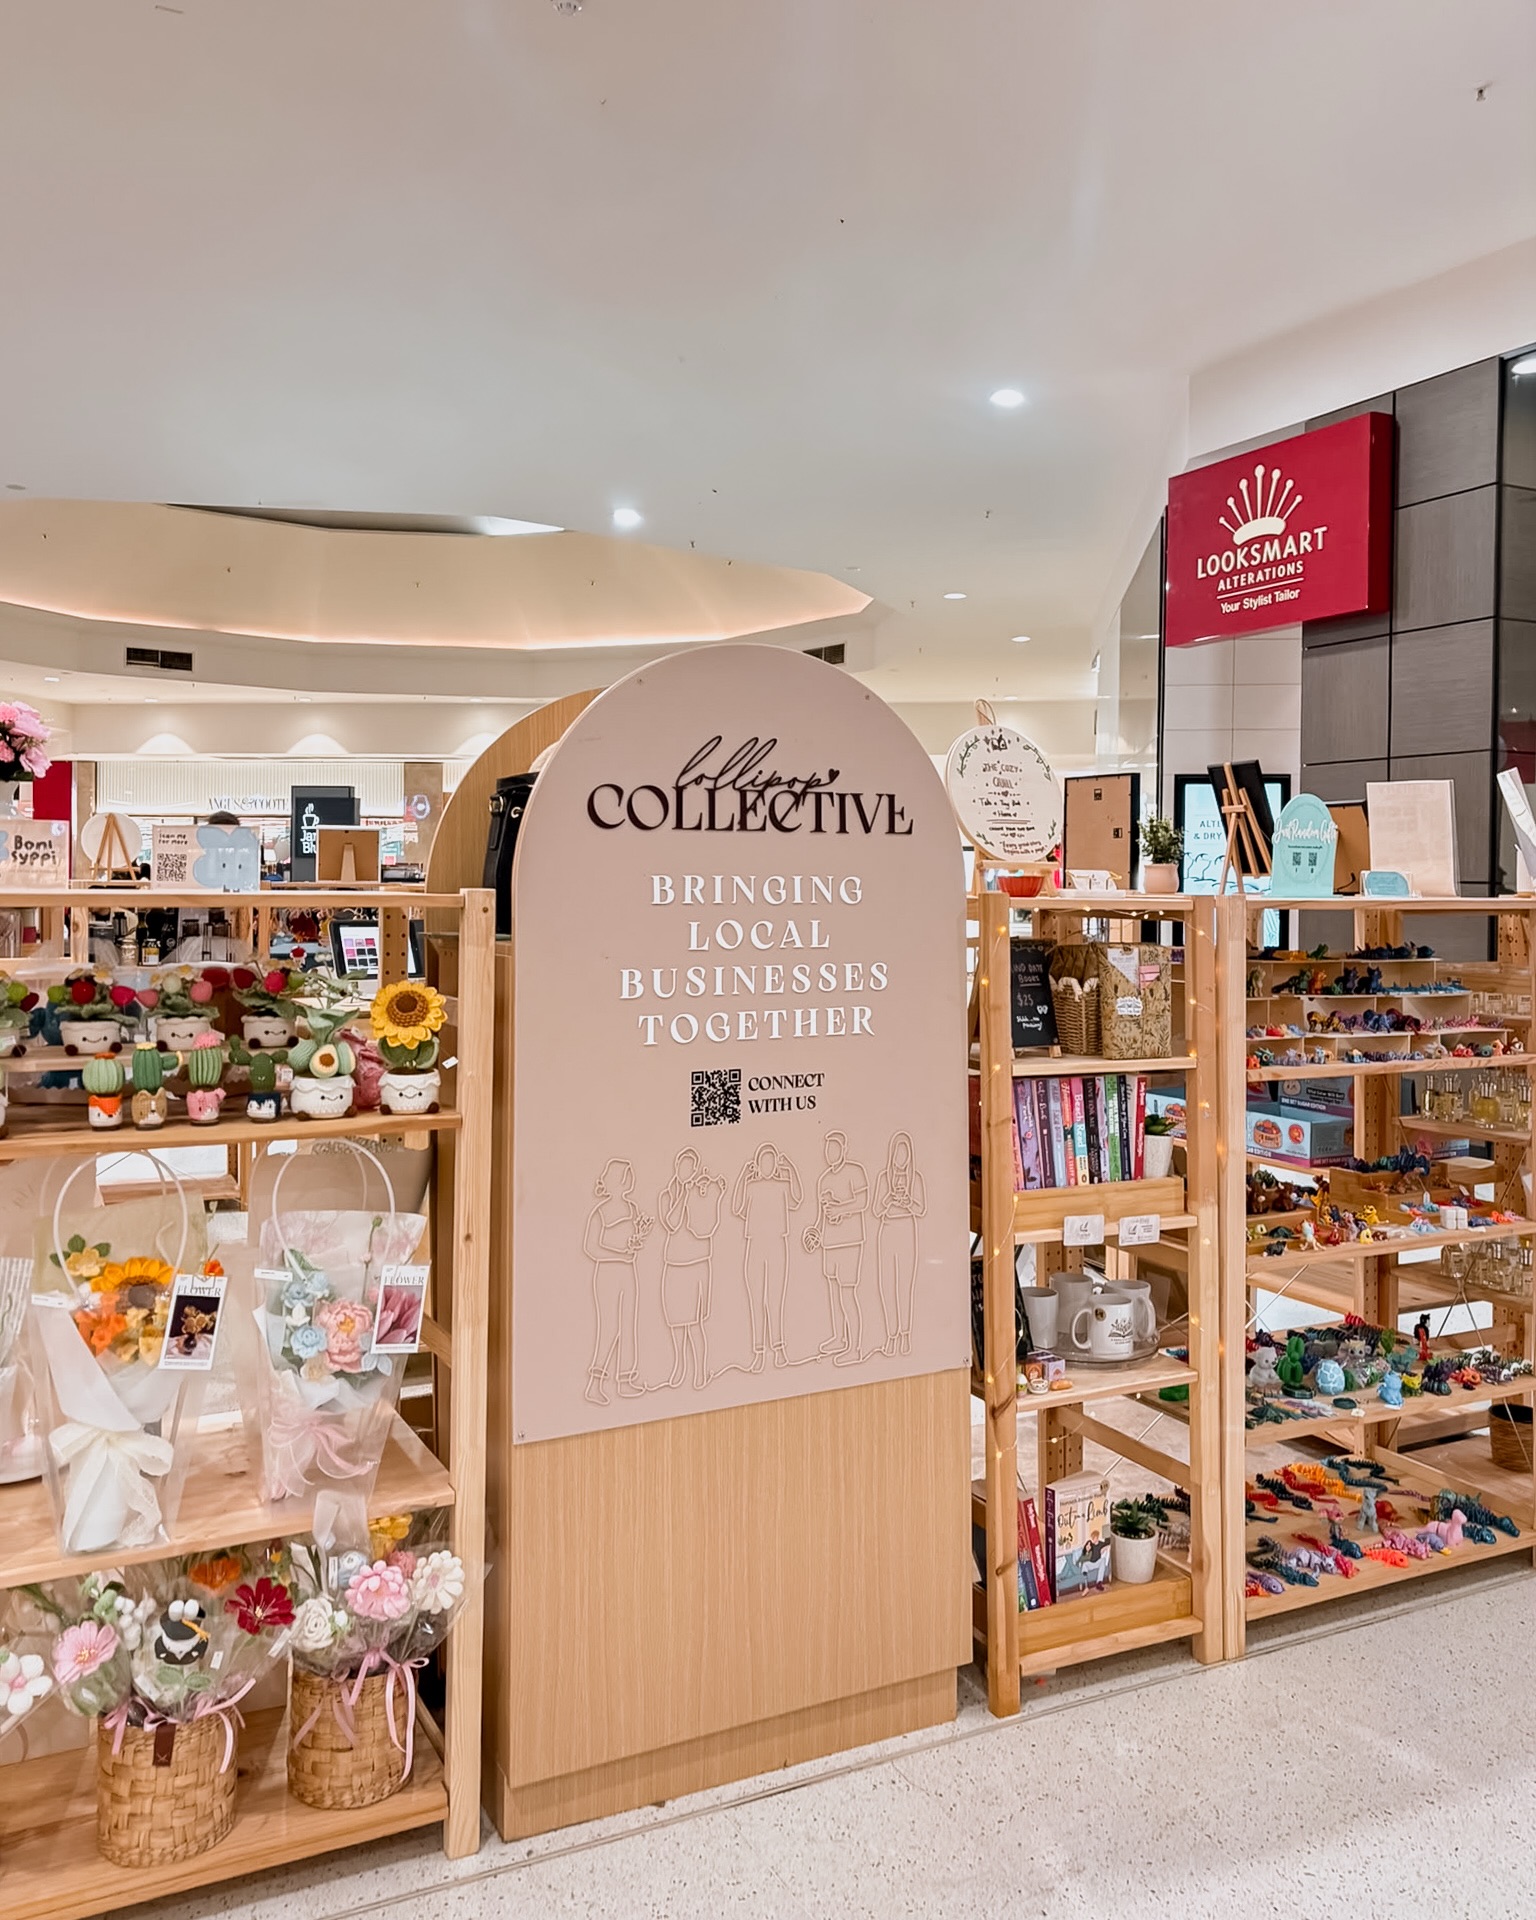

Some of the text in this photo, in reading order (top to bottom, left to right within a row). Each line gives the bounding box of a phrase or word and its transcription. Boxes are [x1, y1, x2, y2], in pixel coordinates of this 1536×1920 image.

[1197, 526, 1328, 579] LOOKSMART
[1217, 560, 1304, 592] ALTERATIONS
[1220, 588, 1301, 614] Your Stylist Tailor
[674, 735, 832, 827] lollipop
[586, 783, 914, 835] COLLECTIVE
[1203, 832, 1223, 840] DRY
[651, 875, 863, 905] BRINGING
[688, 919, 830, 951] LOCAL
[619, 962, 889, 1000] BUSINESSES
[638, 1006, 876, 1046] TOGETHER
[748, 1073, 825, 1092] CONNECT
[748, 1095, 817, 1114] WITH US
[1074, 1094, 1084, 1123] Beach
[1077, 1124, 1087, 1149] Read
[384, 1274, 425, 1285] FLOWER
